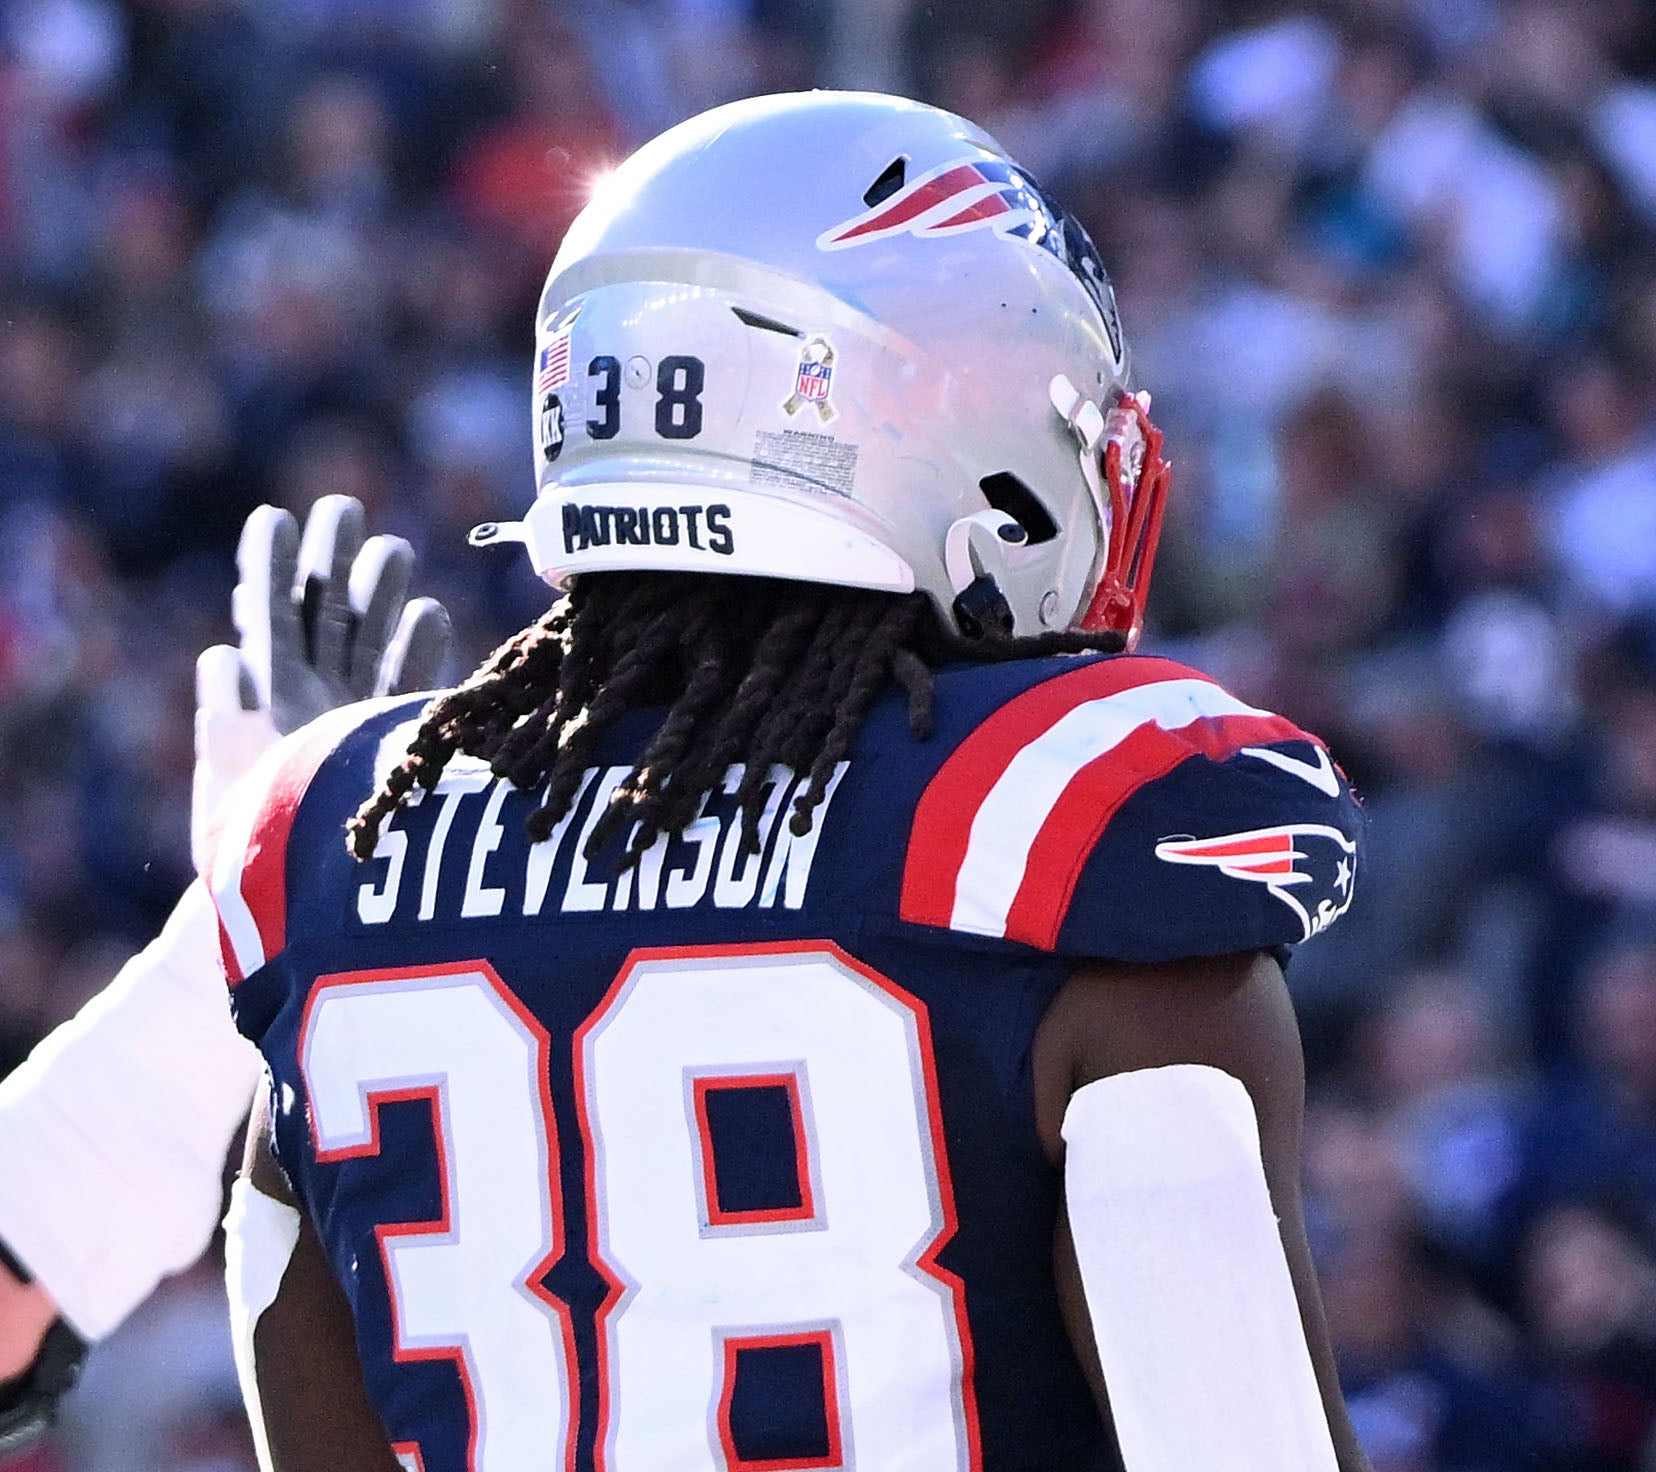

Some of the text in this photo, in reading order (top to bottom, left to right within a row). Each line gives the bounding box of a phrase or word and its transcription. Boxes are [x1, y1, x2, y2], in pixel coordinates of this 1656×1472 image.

[586, 355, 705, 440] 38
[798, 375, 827, 399] NFL
[562, 503, 735, 556] PATRIOTS
[357, 760, 851, 925] STEVENSON
